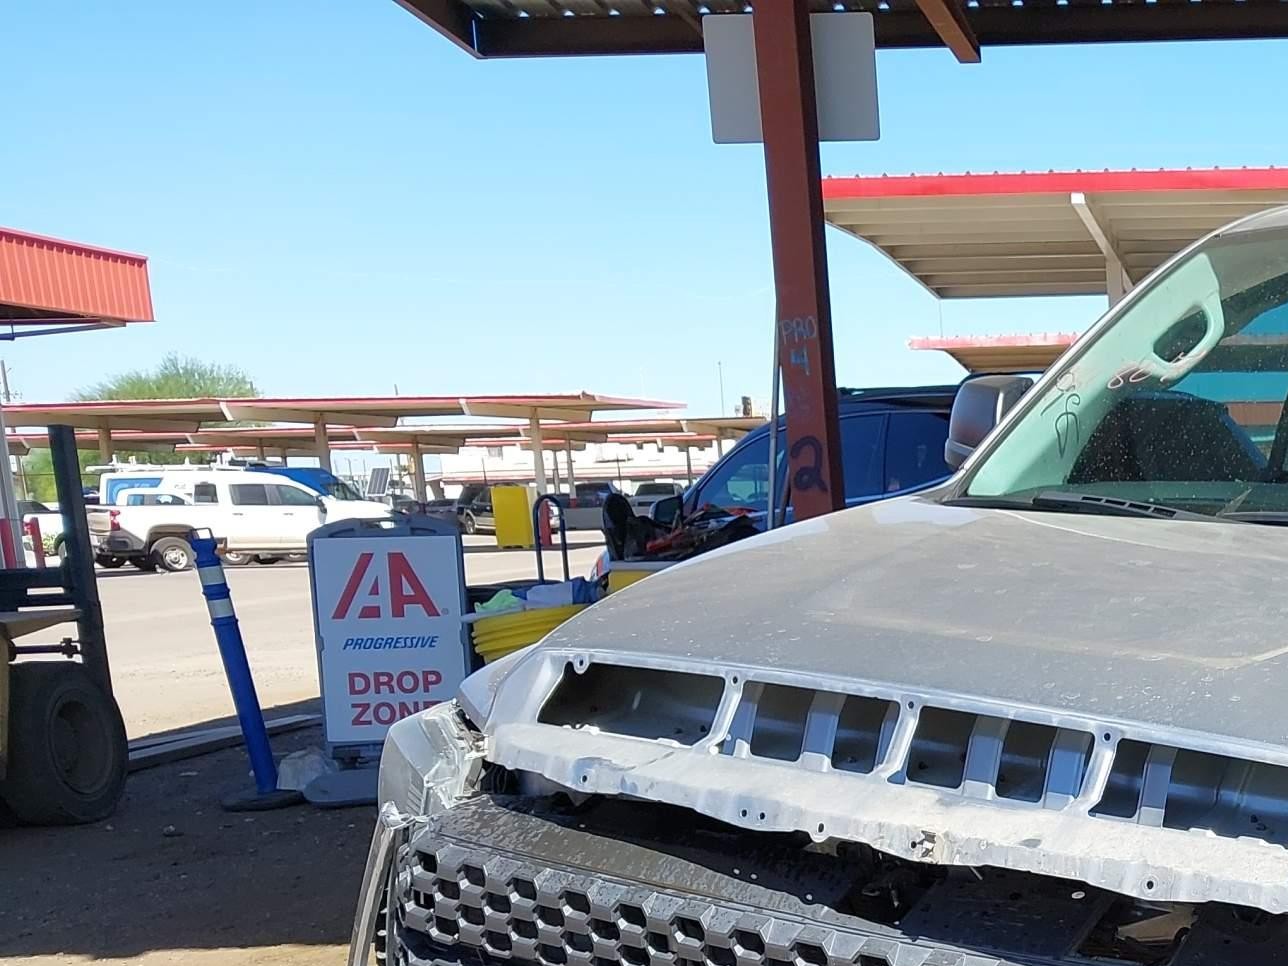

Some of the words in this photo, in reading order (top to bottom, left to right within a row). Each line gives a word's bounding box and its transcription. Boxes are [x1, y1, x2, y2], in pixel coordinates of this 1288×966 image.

[790, 435, 828, 491] 2
[343, 636, 439, 650] PROGRESSIVE
[348, 671, 442, 695] DROP
